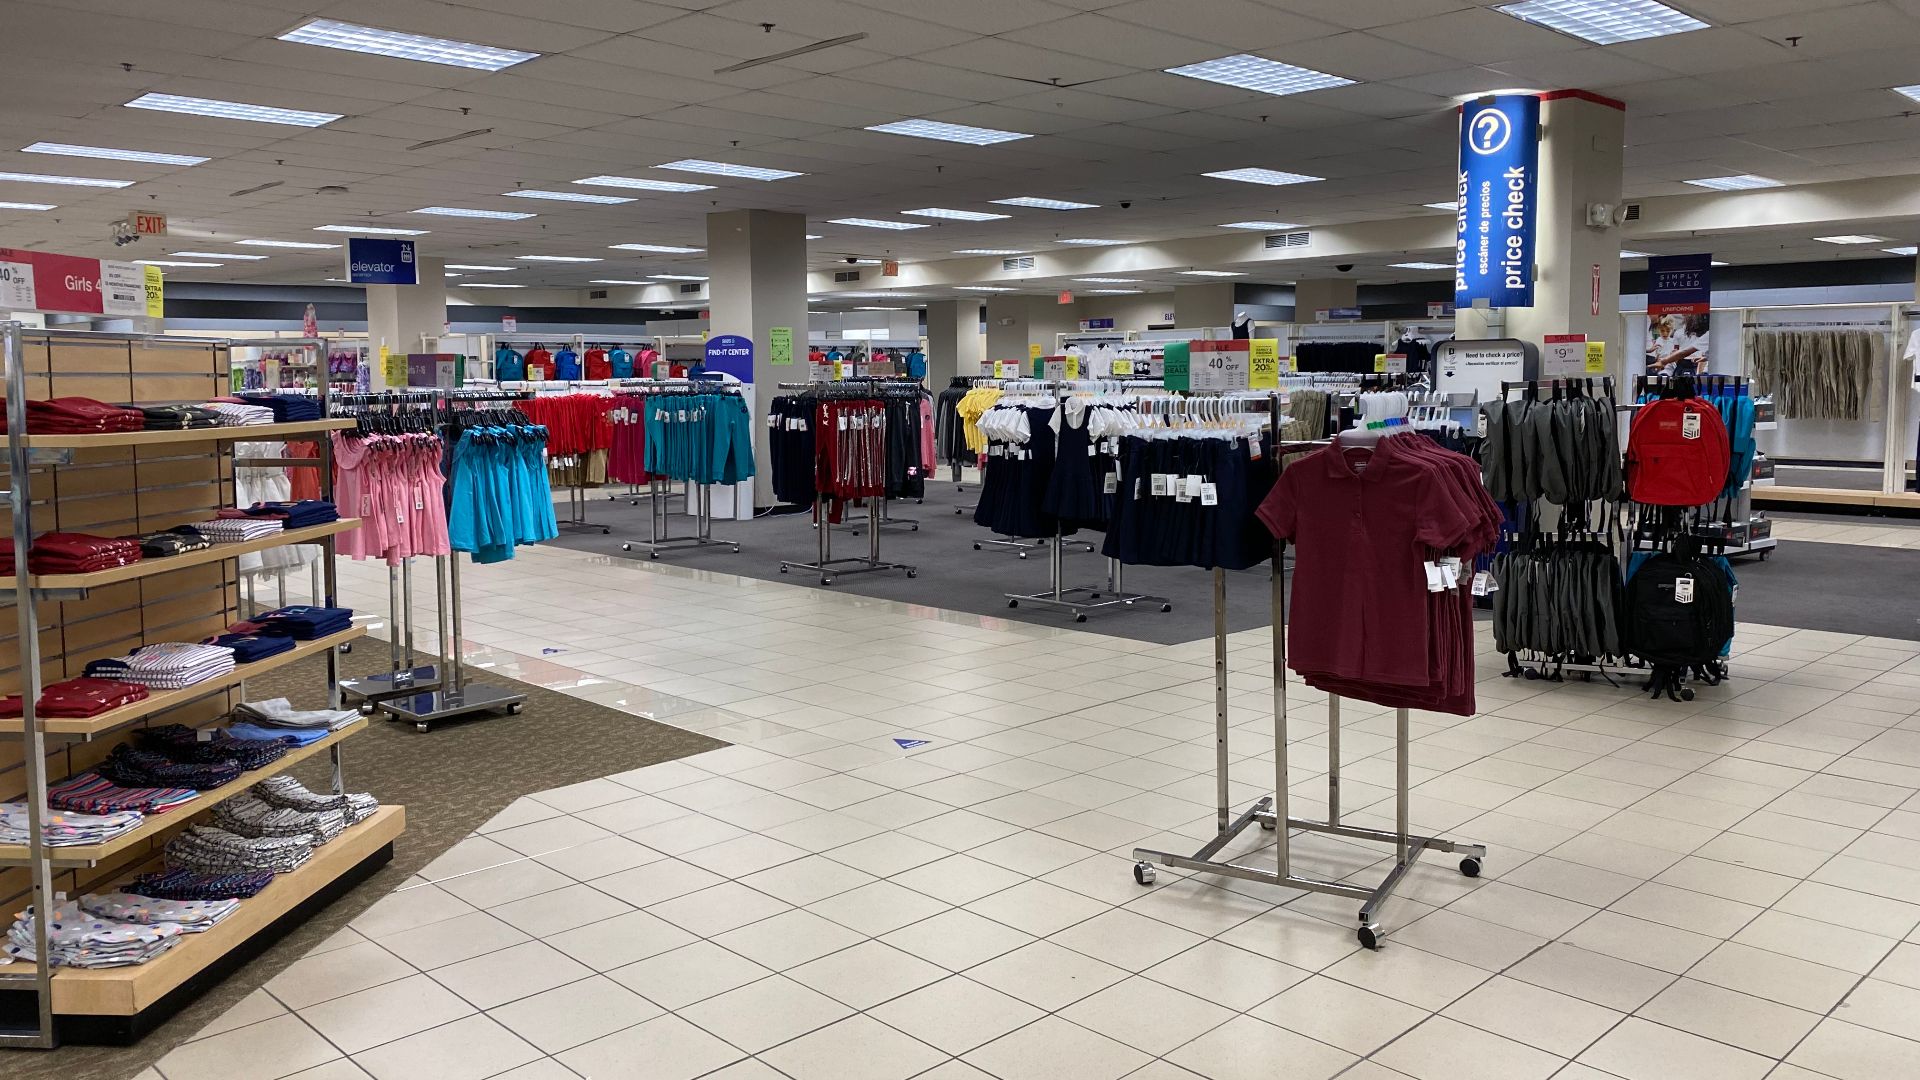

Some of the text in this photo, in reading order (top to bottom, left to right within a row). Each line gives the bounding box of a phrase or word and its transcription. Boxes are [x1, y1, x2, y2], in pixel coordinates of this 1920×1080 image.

[137, 215, 162, 234] EXIT
[1478, 180, 1492, 275] escáner de precios
[1501, 166, 1525, 289] price check
[351, 261, 395, 273] elevator
[13, 277, 25, 285] OFF
[1660, 273, 1699, 281] SIMPLY
[65, 275, 92, 293] Girls
[145, 284, 162, 292] EXTRA
[1659, 280, 1700, 288] STYLED
[728, 348, 750, 356] CENTER
[1211, 344, 1229, 352] SALE
[1208, 358, 1223, 369] 40
[1165, 366, 1188, 374] DEALS
